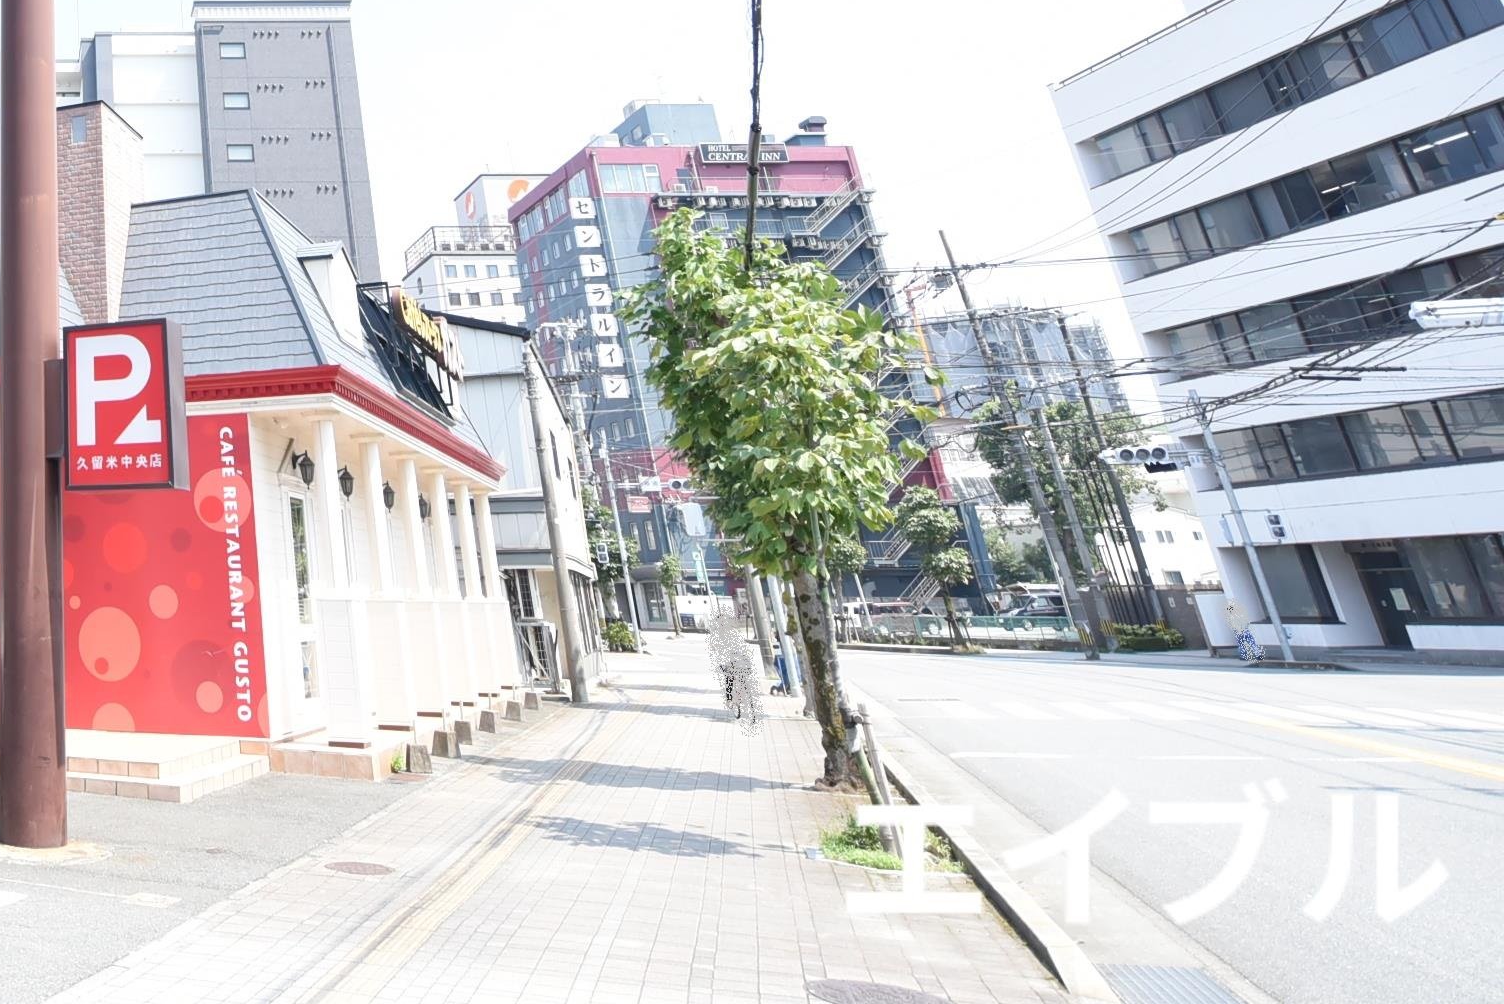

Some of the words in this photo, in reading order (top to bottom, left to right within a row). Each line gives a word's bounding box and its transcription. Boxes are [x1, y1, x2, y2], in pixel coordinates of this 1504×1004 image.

[708, 144, 731, 152] HOTEL
[761, 152, 781, 161] INN
[576, 200, 623, 394] セントラルイン
[75, 334, 152, 446] P
[77, 453, 162, 471] 久留米中央店
[219, 426, 243, 478] CAFÉ
[222, 486, 247, 632] RESTAURANT
[233, 641, 252, 722] GUSTO
